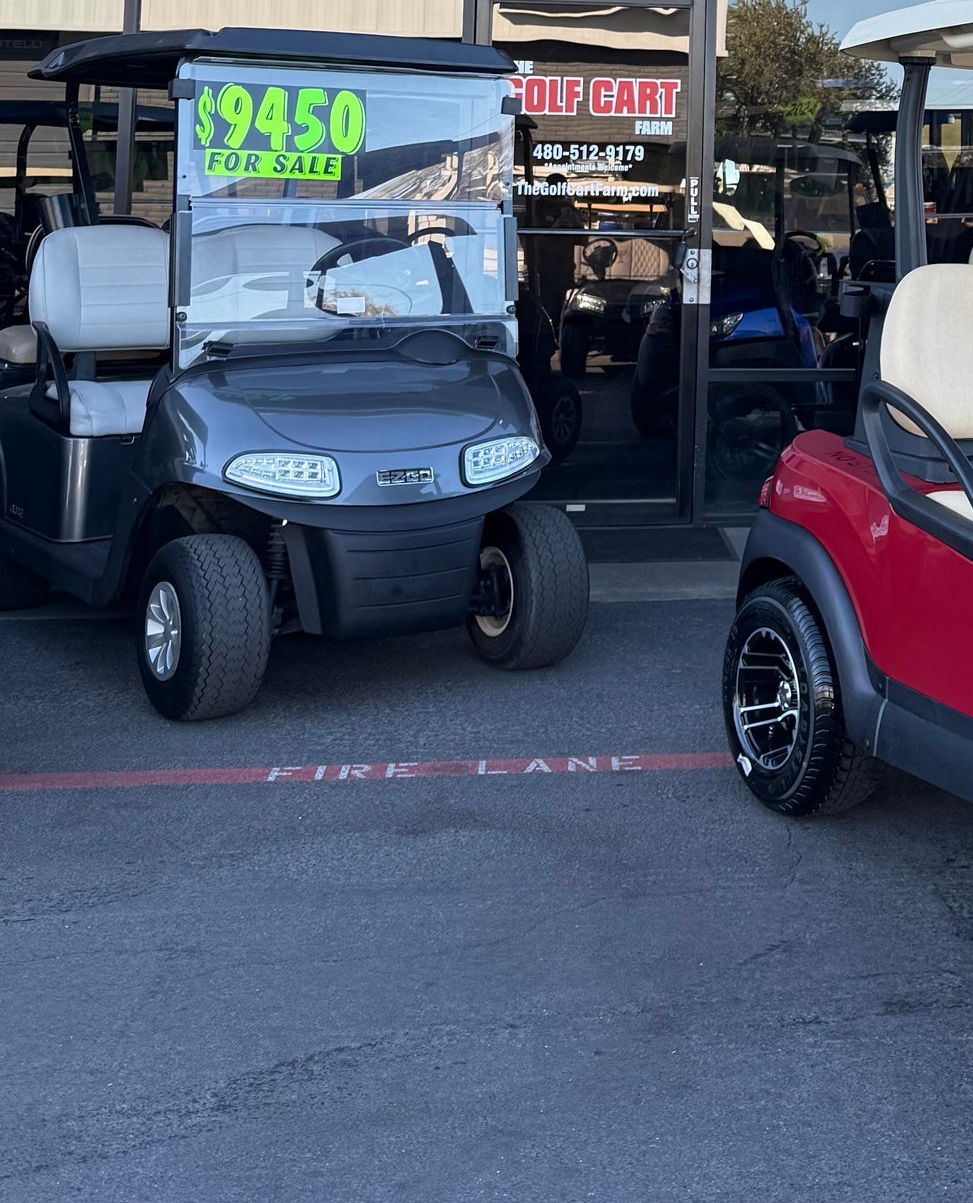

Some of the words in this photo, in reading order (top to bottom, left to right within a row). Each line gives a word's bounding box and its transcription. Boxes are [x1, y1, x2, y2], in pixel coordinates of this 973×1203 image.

[513, 60, 533, 74] HE
[589, 77, 681, 117] CART
[196, 83, 366, 155] $9450
[635, 121, 673, 136] FARM
[207, 152, 263, 173] FOR
[272, 153, 338, 176] SALE
[533, 144, 645, 161] 480-512-9179
[517, 181, 659, 198] TheGolfCartFarm.com
[690, 179, 699, 215] PULL
[266, 762, 418, 782] FIRE
[478, 755, 642, 776] LANE
